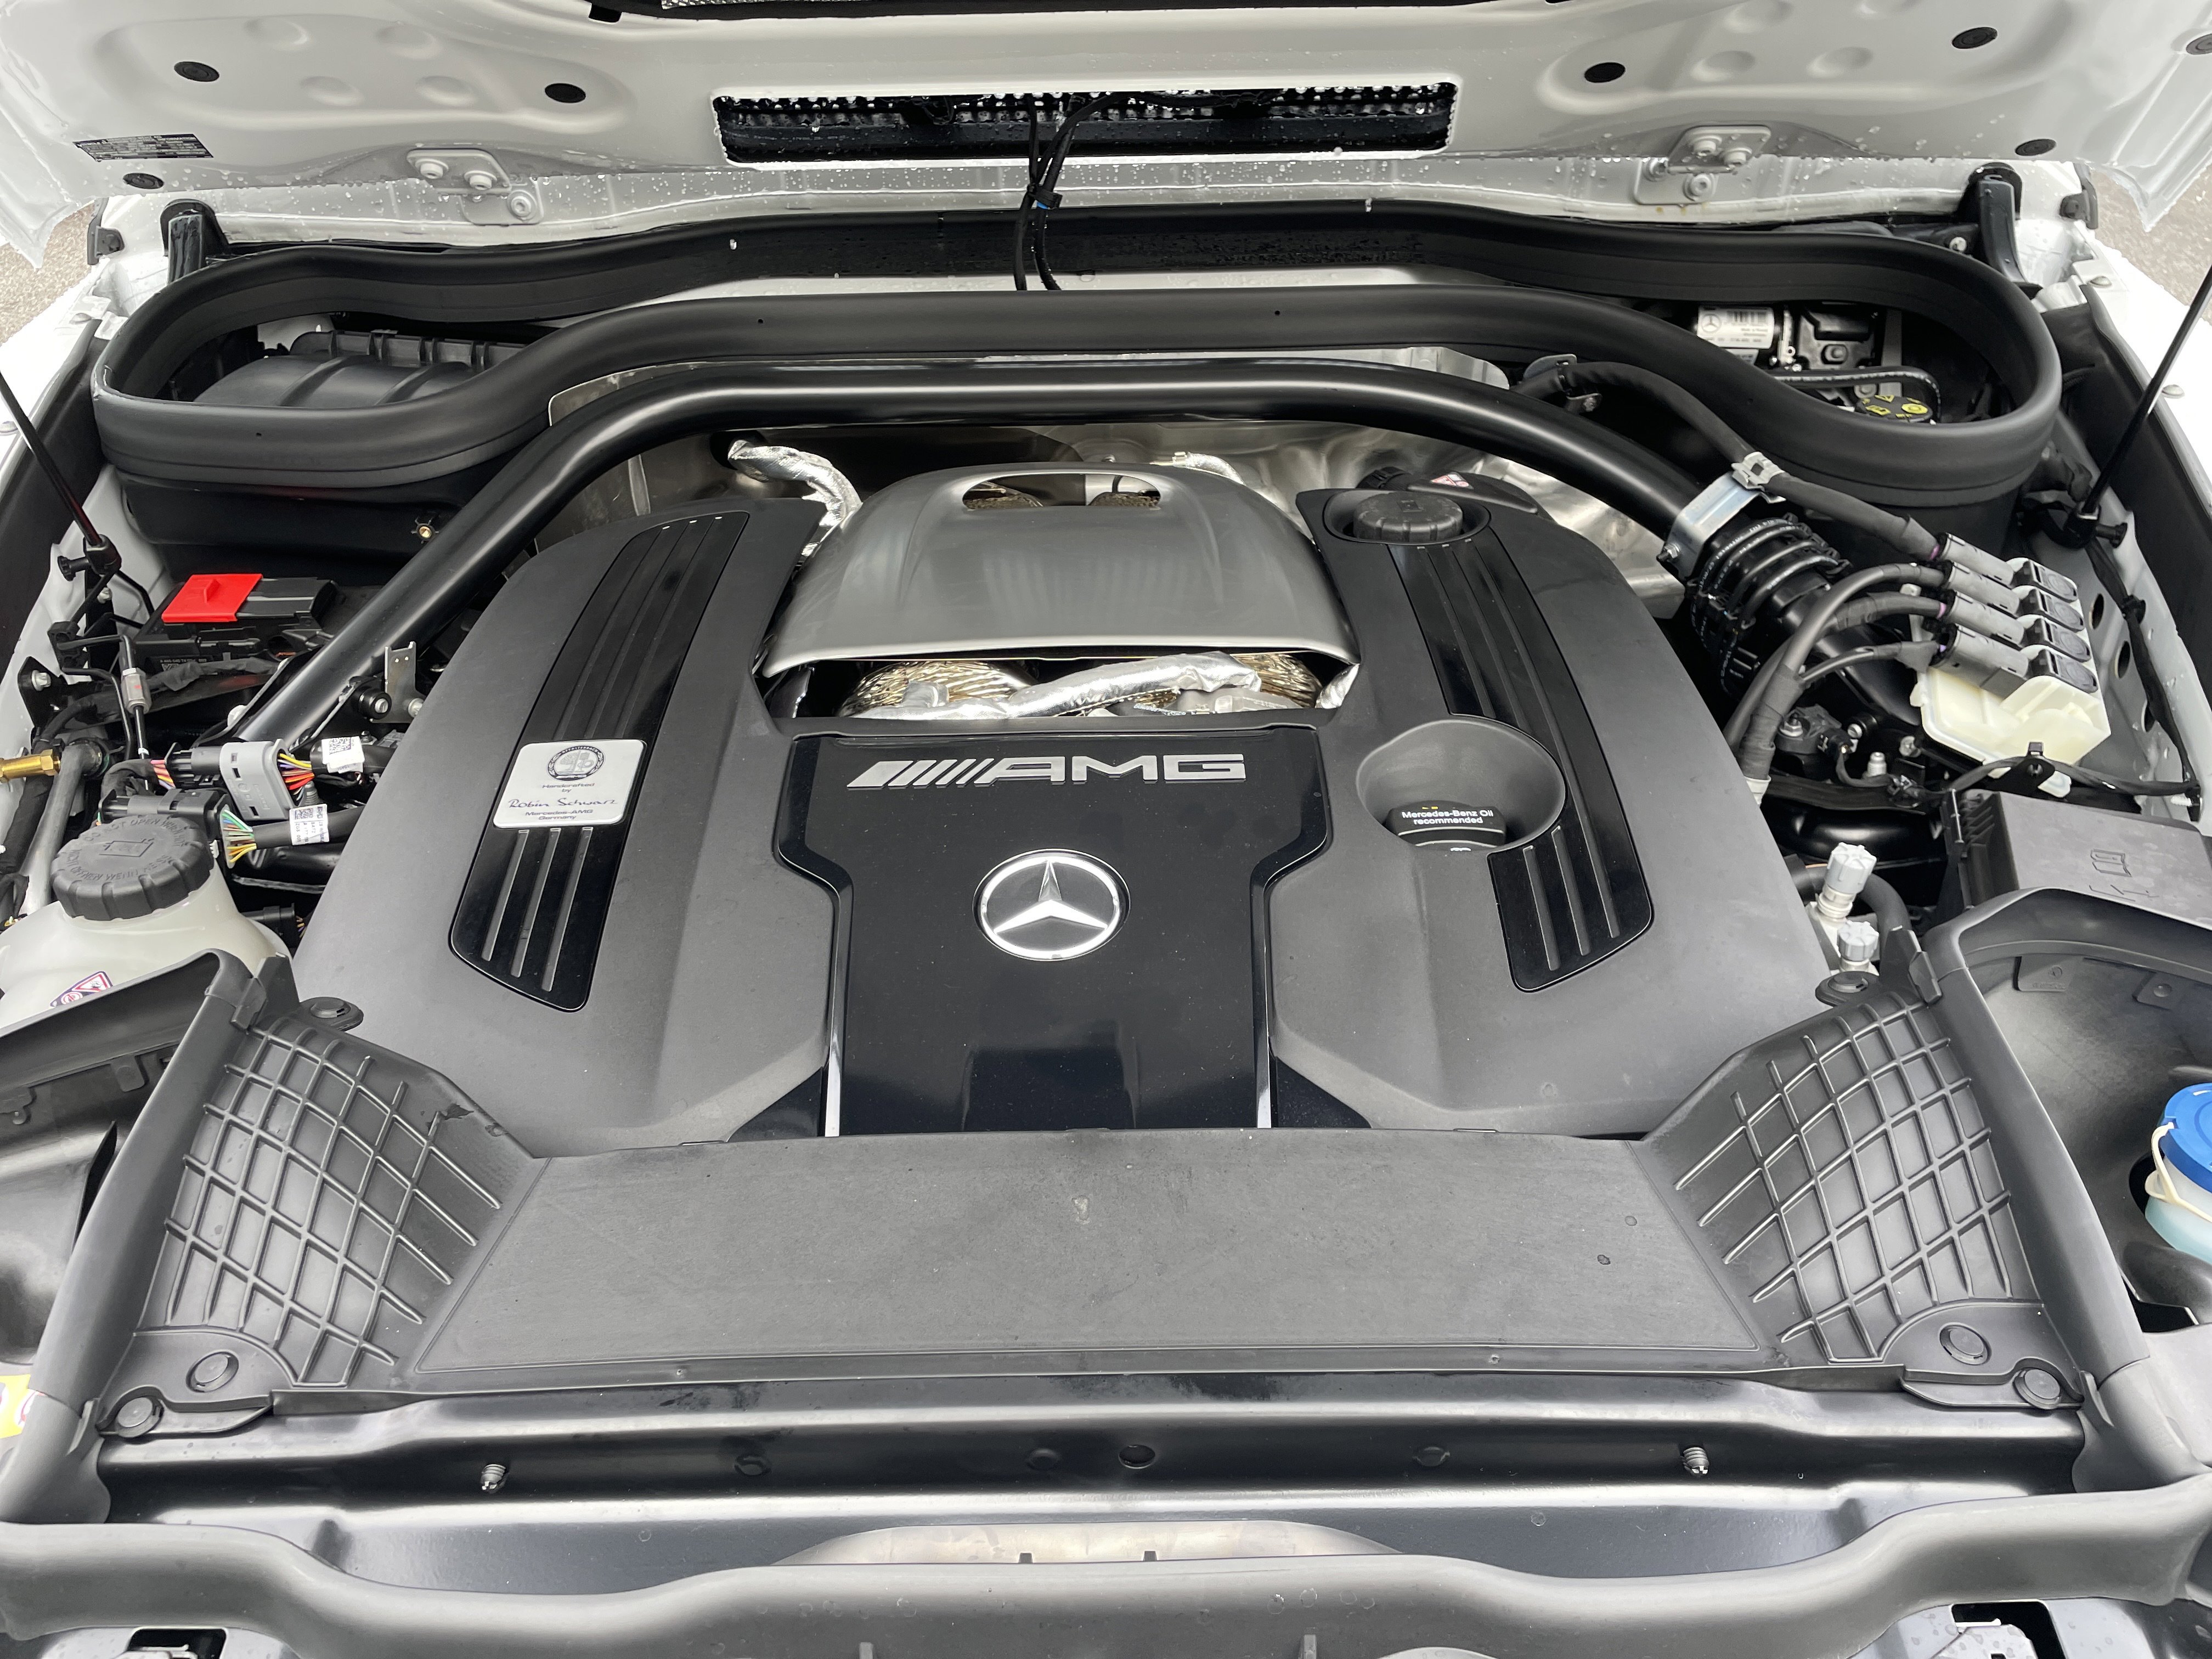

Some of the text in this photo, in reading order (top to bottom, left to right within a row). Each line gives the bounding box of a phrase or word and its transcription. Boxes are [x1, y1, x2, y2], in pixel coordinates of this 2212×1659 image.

[974, 754, 1247, 786] AMG
[508, 799, 549, 808] Robin
[1402, 810, 1478, 818] Mercedes-Benz
